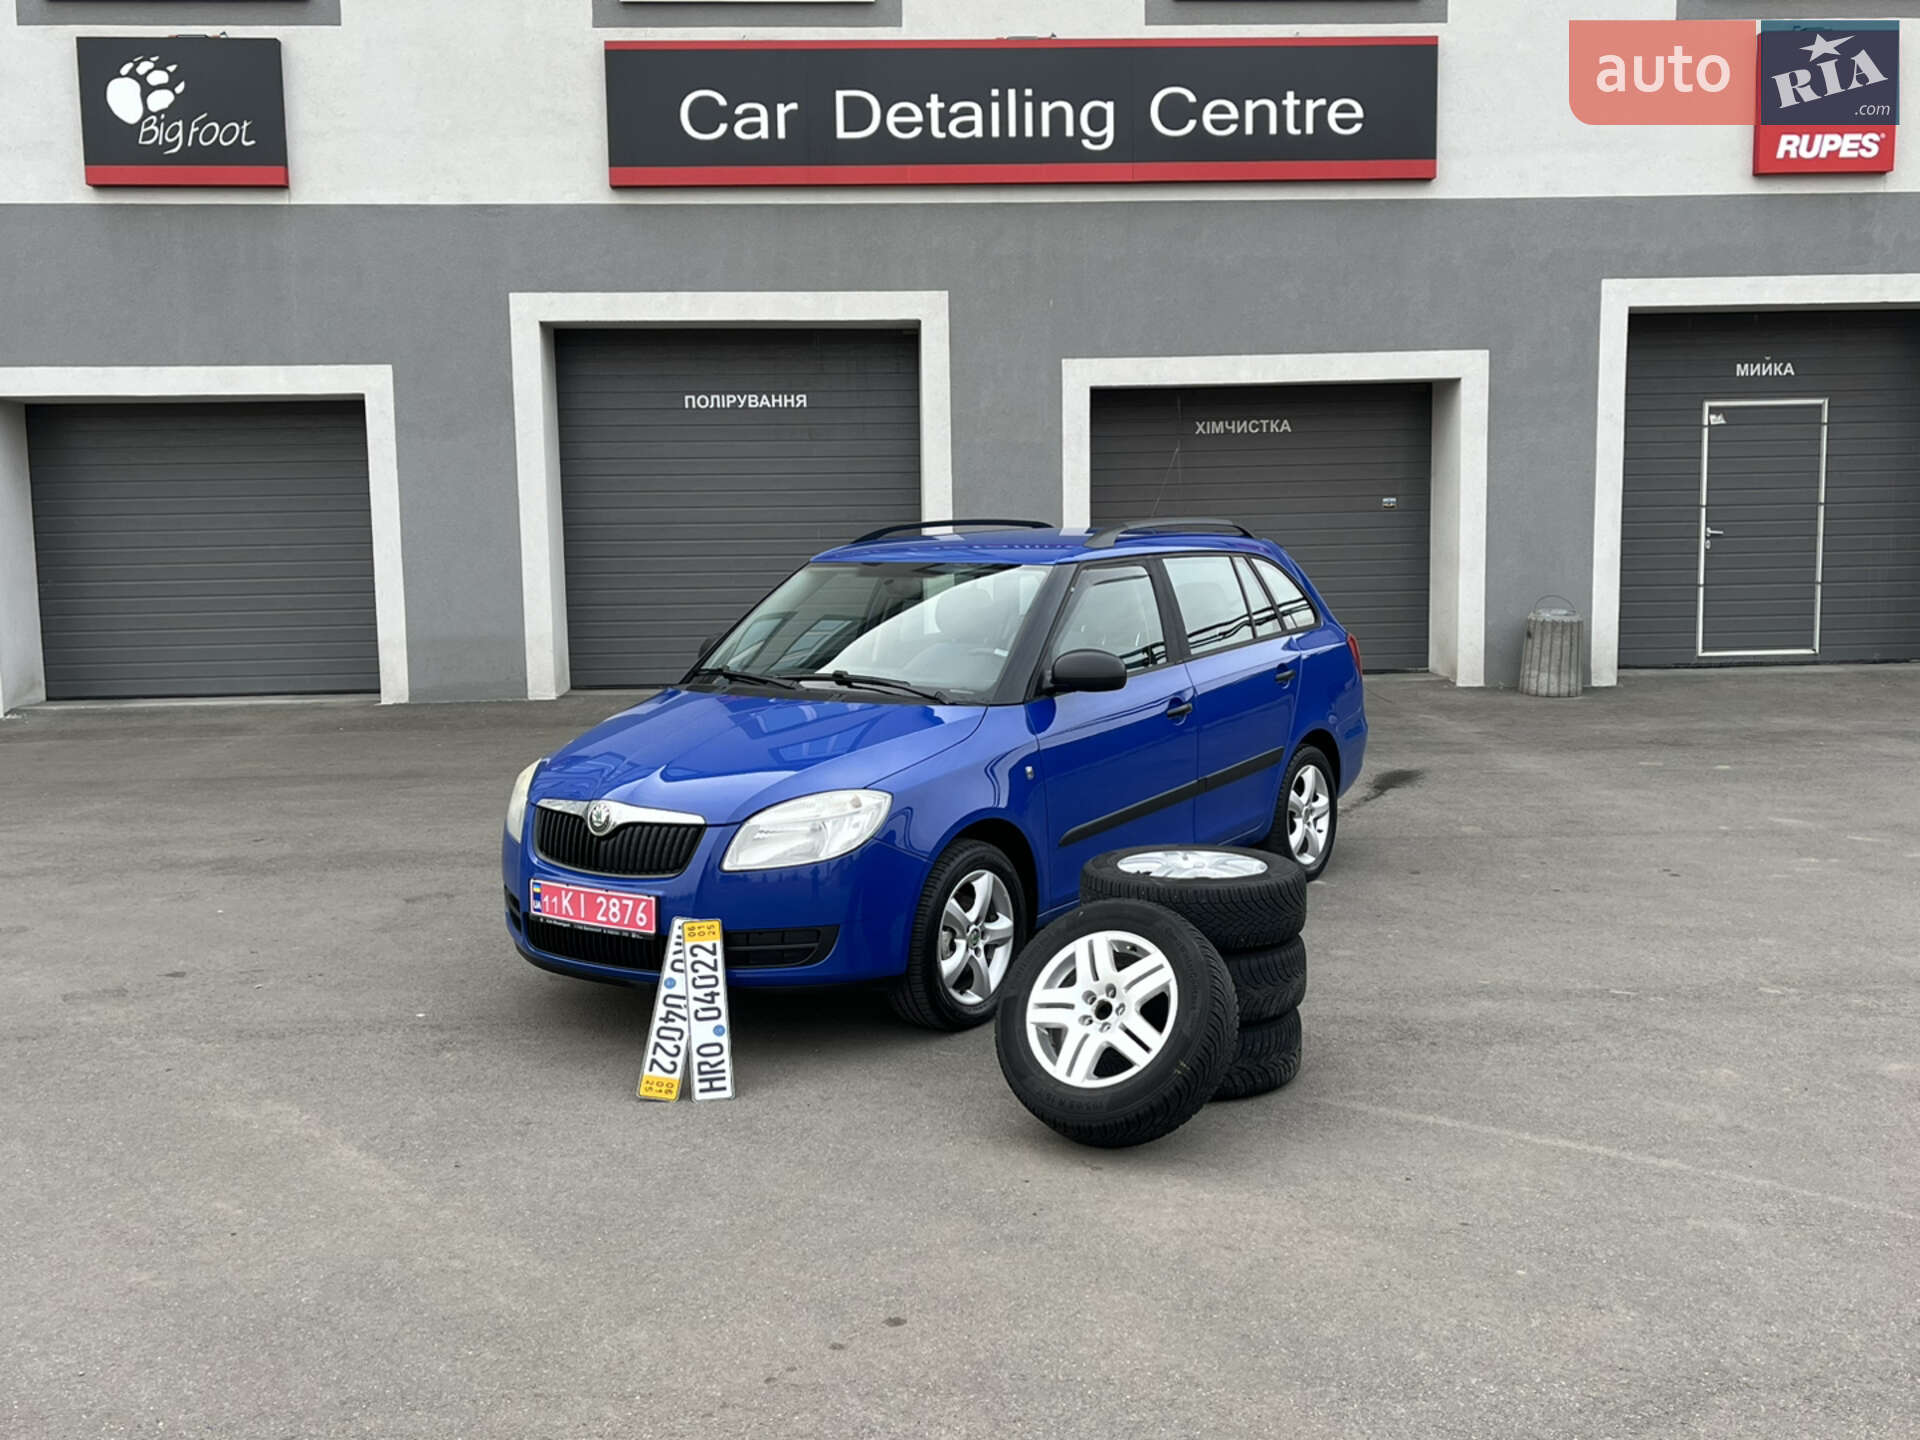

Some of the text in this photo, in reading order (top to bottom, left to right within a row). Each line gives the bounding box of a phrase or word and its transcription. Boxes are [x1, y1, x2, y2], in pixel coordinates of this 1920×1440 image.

[679, 86, 1364, 151] Car Detailing Centre
[1735, 355, 1795, 377] МИЙКА
[684, 394, 808, 409] ПОЛІРУВАННЯ
[1195, 419, 1292, 435] ХІМЧИСТКА
[596, 896, 648, 927] 2876
[689, 942, 727, 1093] HRO 04022
